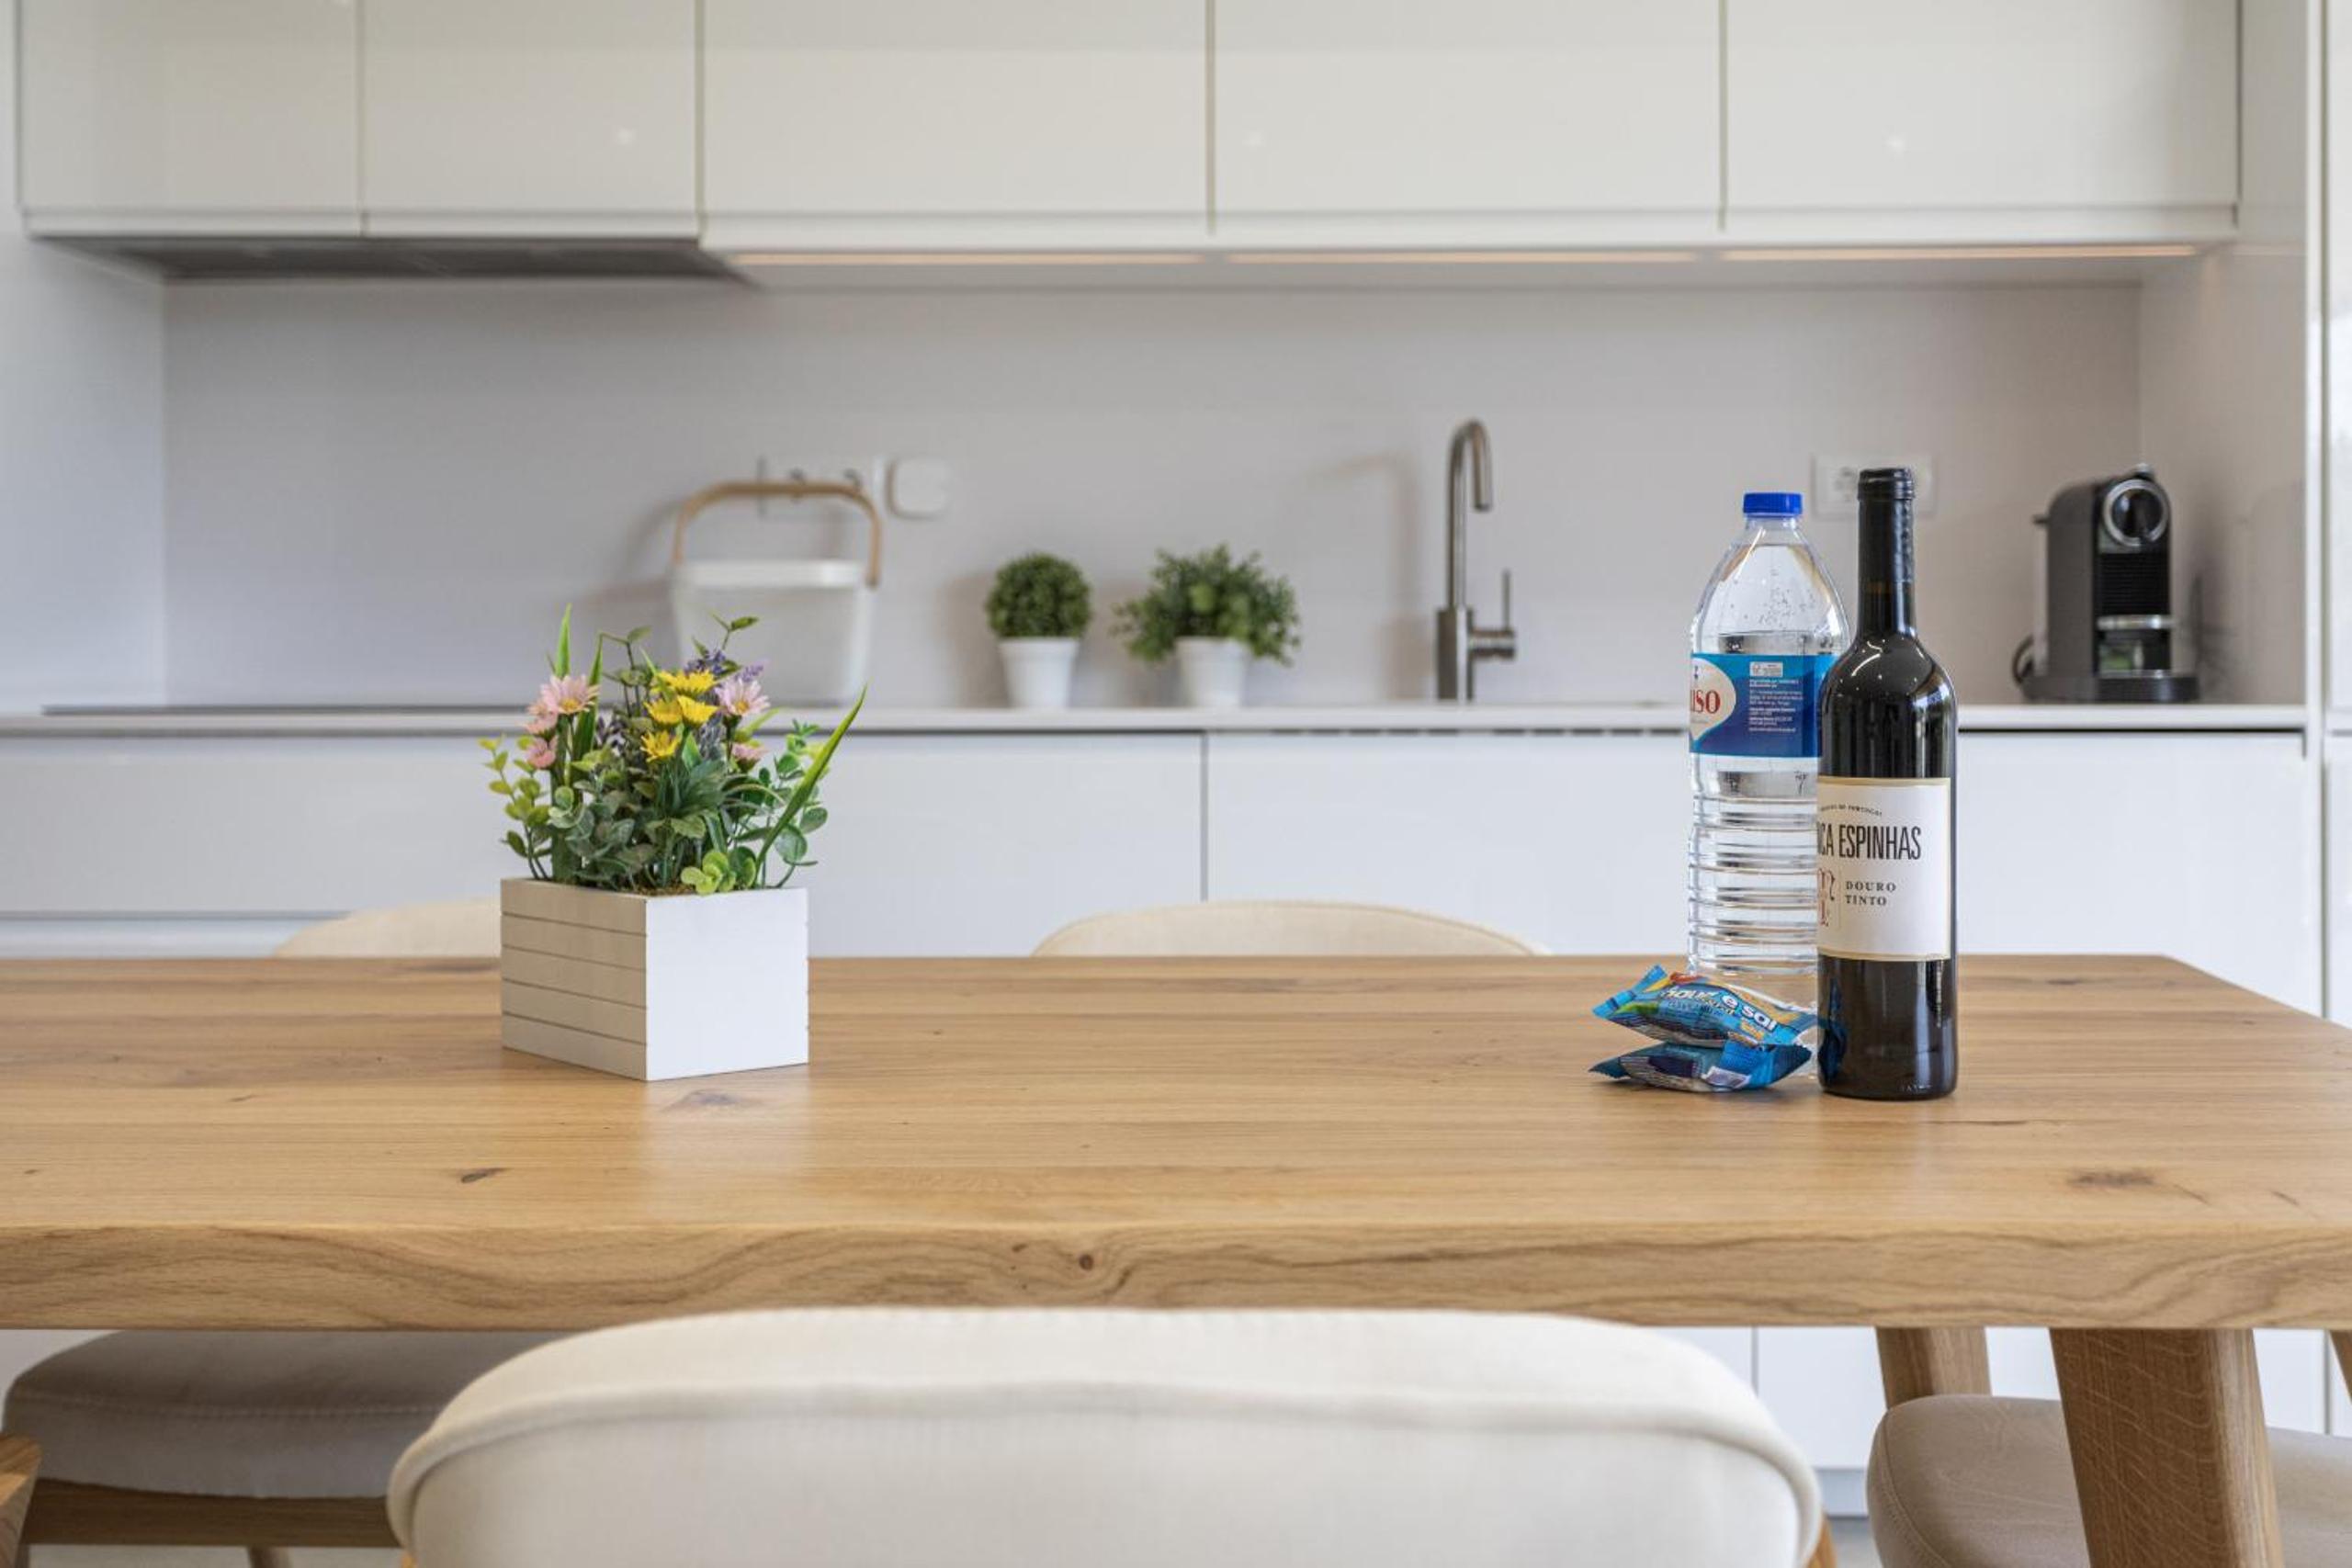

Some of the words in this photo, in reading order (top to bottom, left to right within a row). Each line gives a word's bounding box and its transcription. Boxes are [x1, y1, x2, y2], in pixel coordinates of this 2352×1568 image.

[1838, 824, 1921, 860] ESPINHAS
[1846, 881, 1896, 892] DOURO
[1845, 895, 1887, 906] TINTO
[1741, 1005, 1778, 1032] sal
